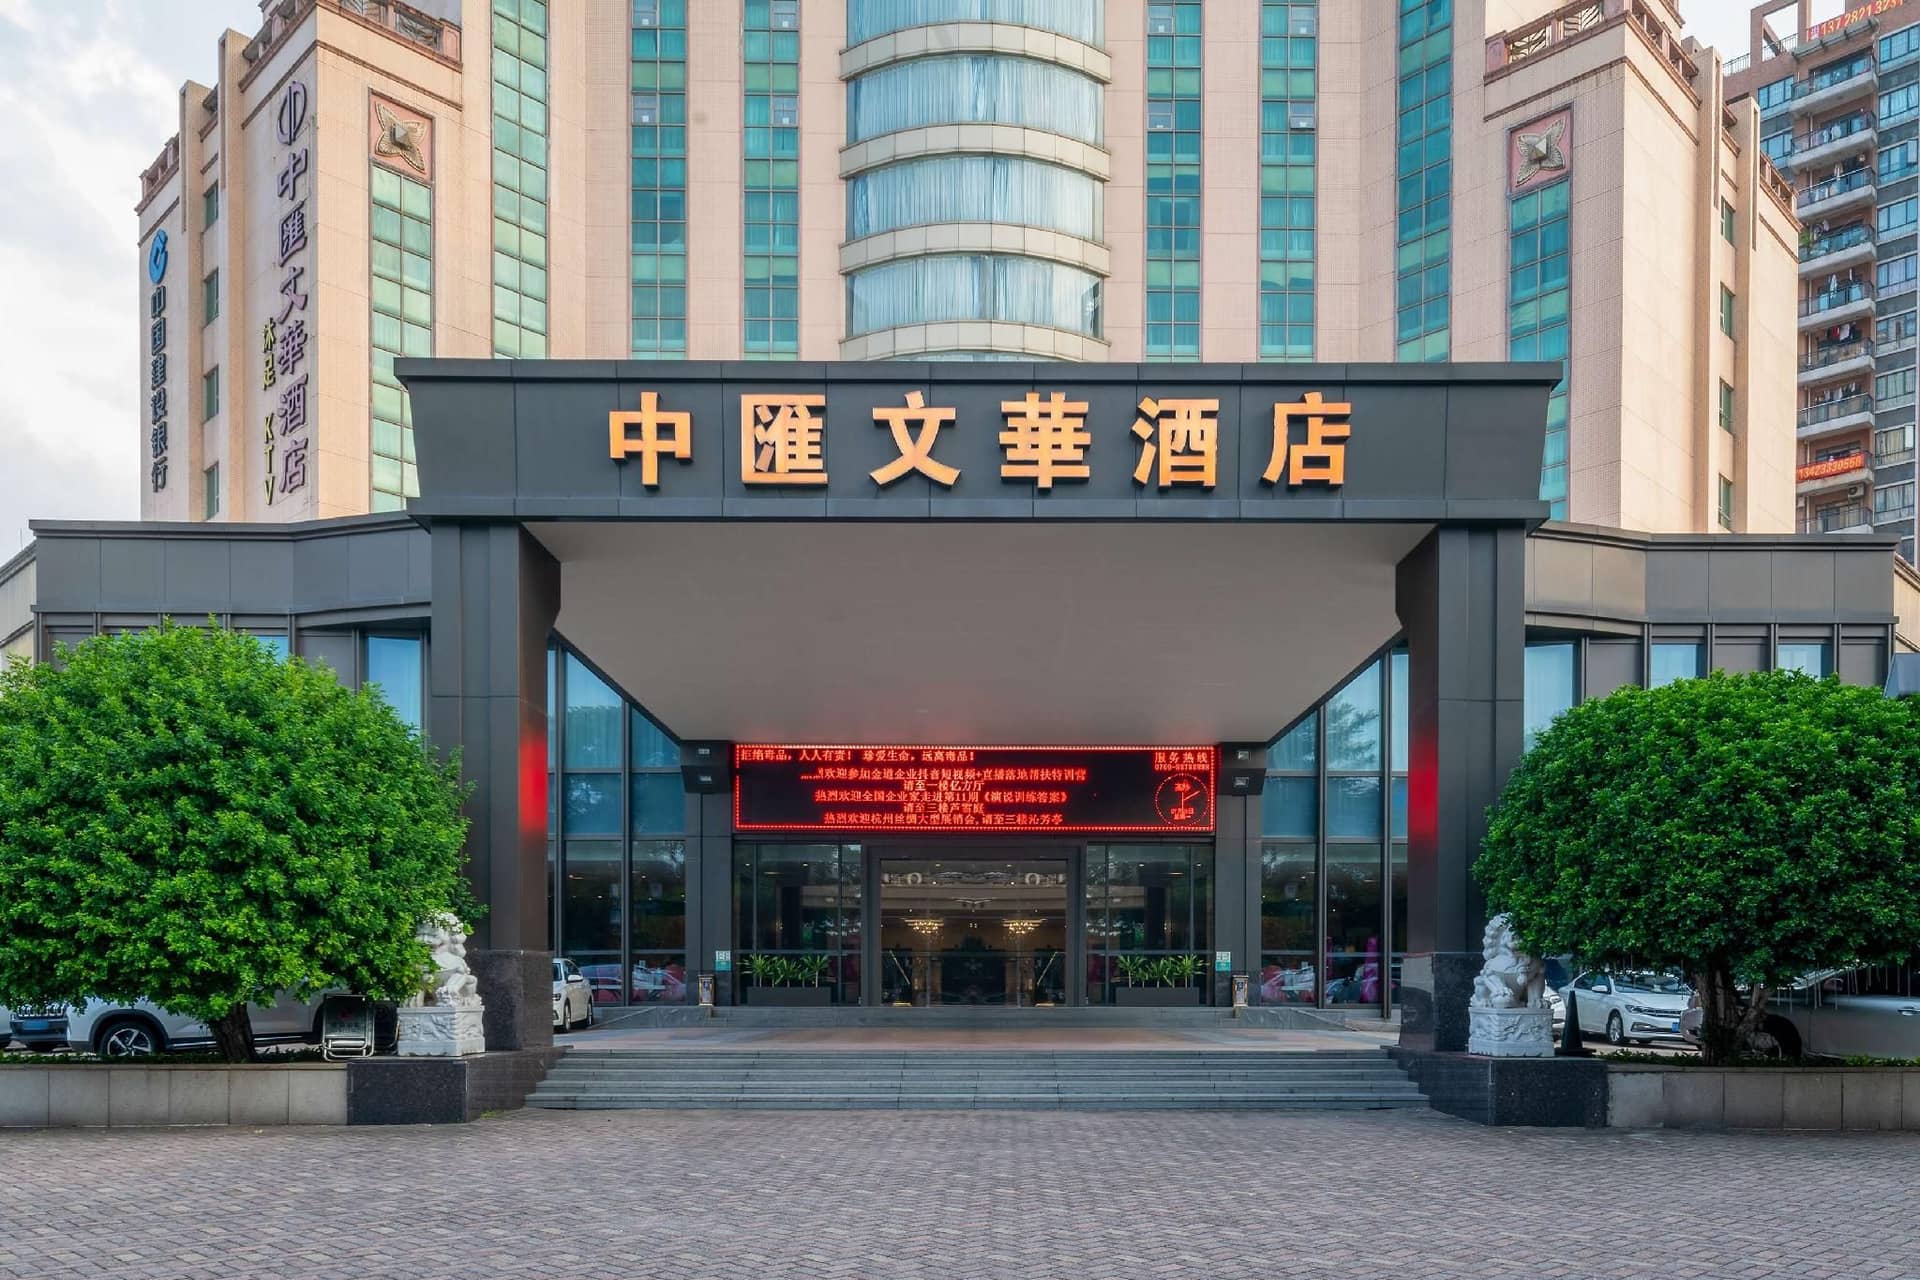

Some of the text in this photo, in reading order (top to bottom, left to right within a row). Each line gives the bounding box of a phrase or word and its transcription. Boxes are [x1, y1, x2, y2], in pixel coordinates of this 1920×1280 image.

[1821, 18, 1841, 35] 137
[276, 150, 309, 494] 中匯文華酒店
[264, 412, 275, 506] KTV
[609, 390, 1354, 489] 中匯文華酒店
[1154, 752, 1208, 763] 服务热线
